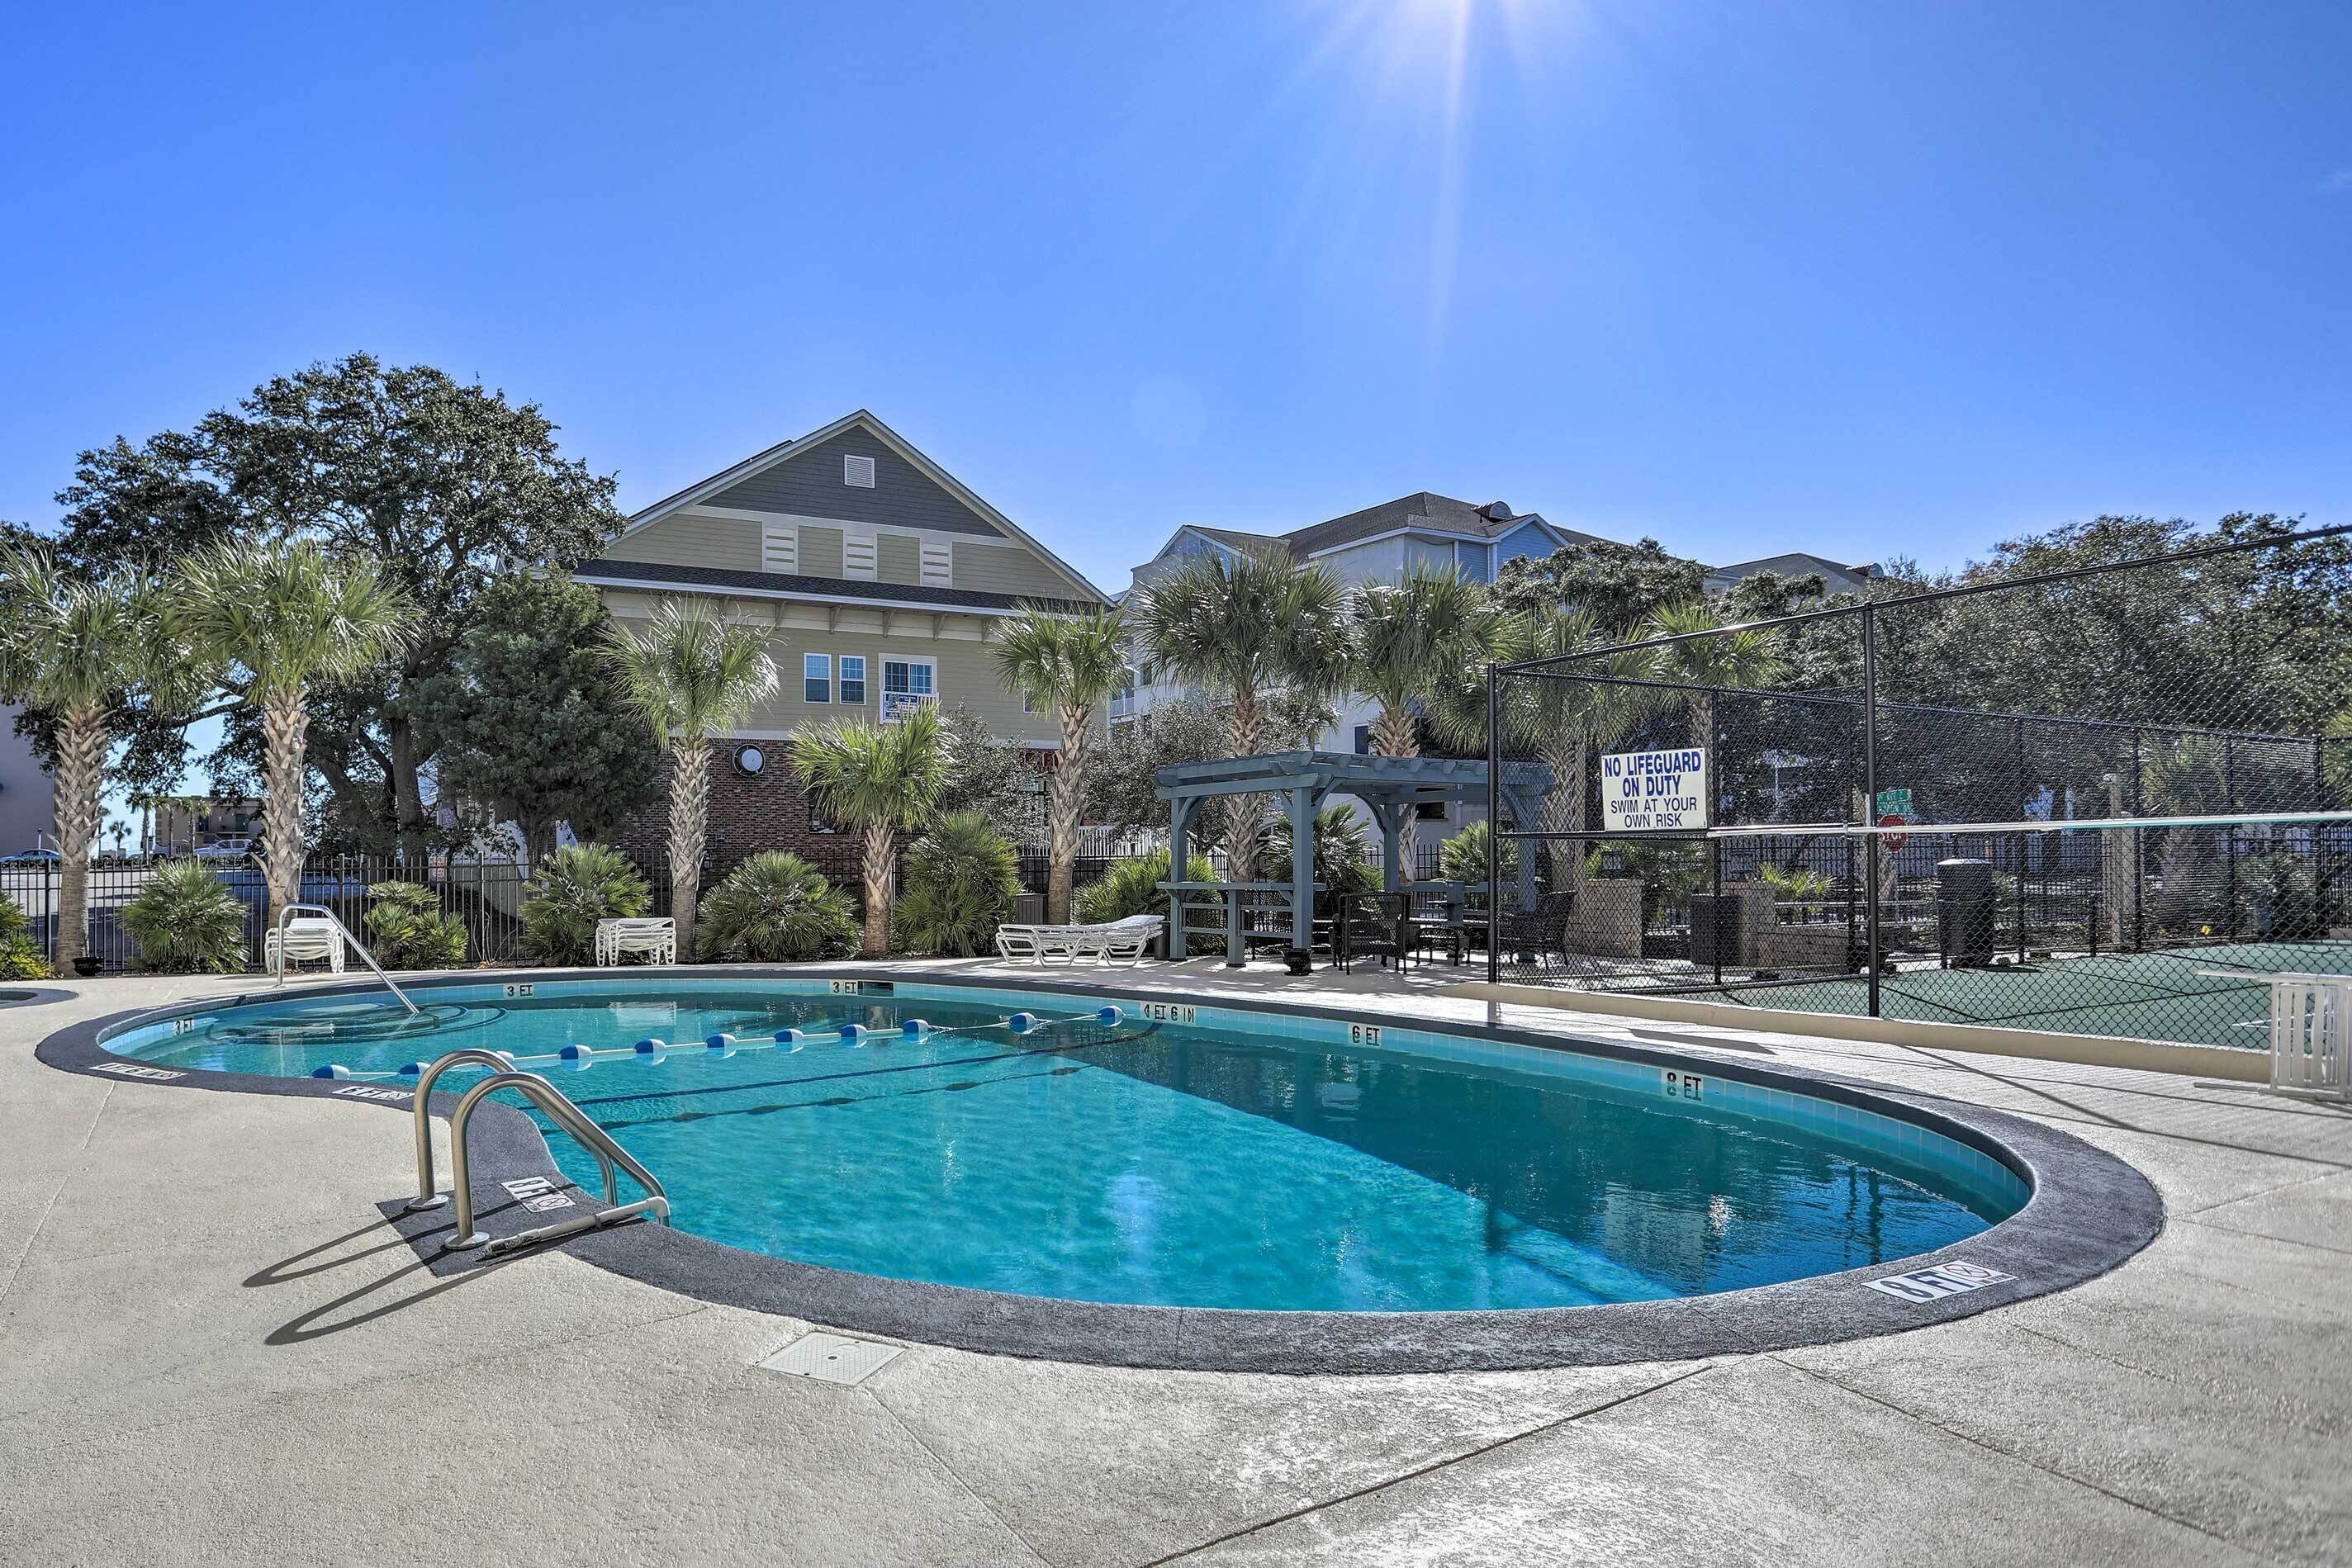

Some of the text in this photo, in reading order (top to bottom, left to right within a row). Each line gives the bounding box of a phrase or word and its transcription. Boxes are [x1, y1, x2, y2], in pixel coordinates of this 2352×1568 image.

[1605, 751, 1700, 777] NO LIFEGUARD
[1623, 775, 1681, 798] ON DUTY
[1610, 797, 1697, 813] SWIM AT YOUR
[1624, 812, 1682, 827] OWN RISK
[507, 1180, 545, 1188] 8
[1880, 1270, 1976, 1299] 8 FT
